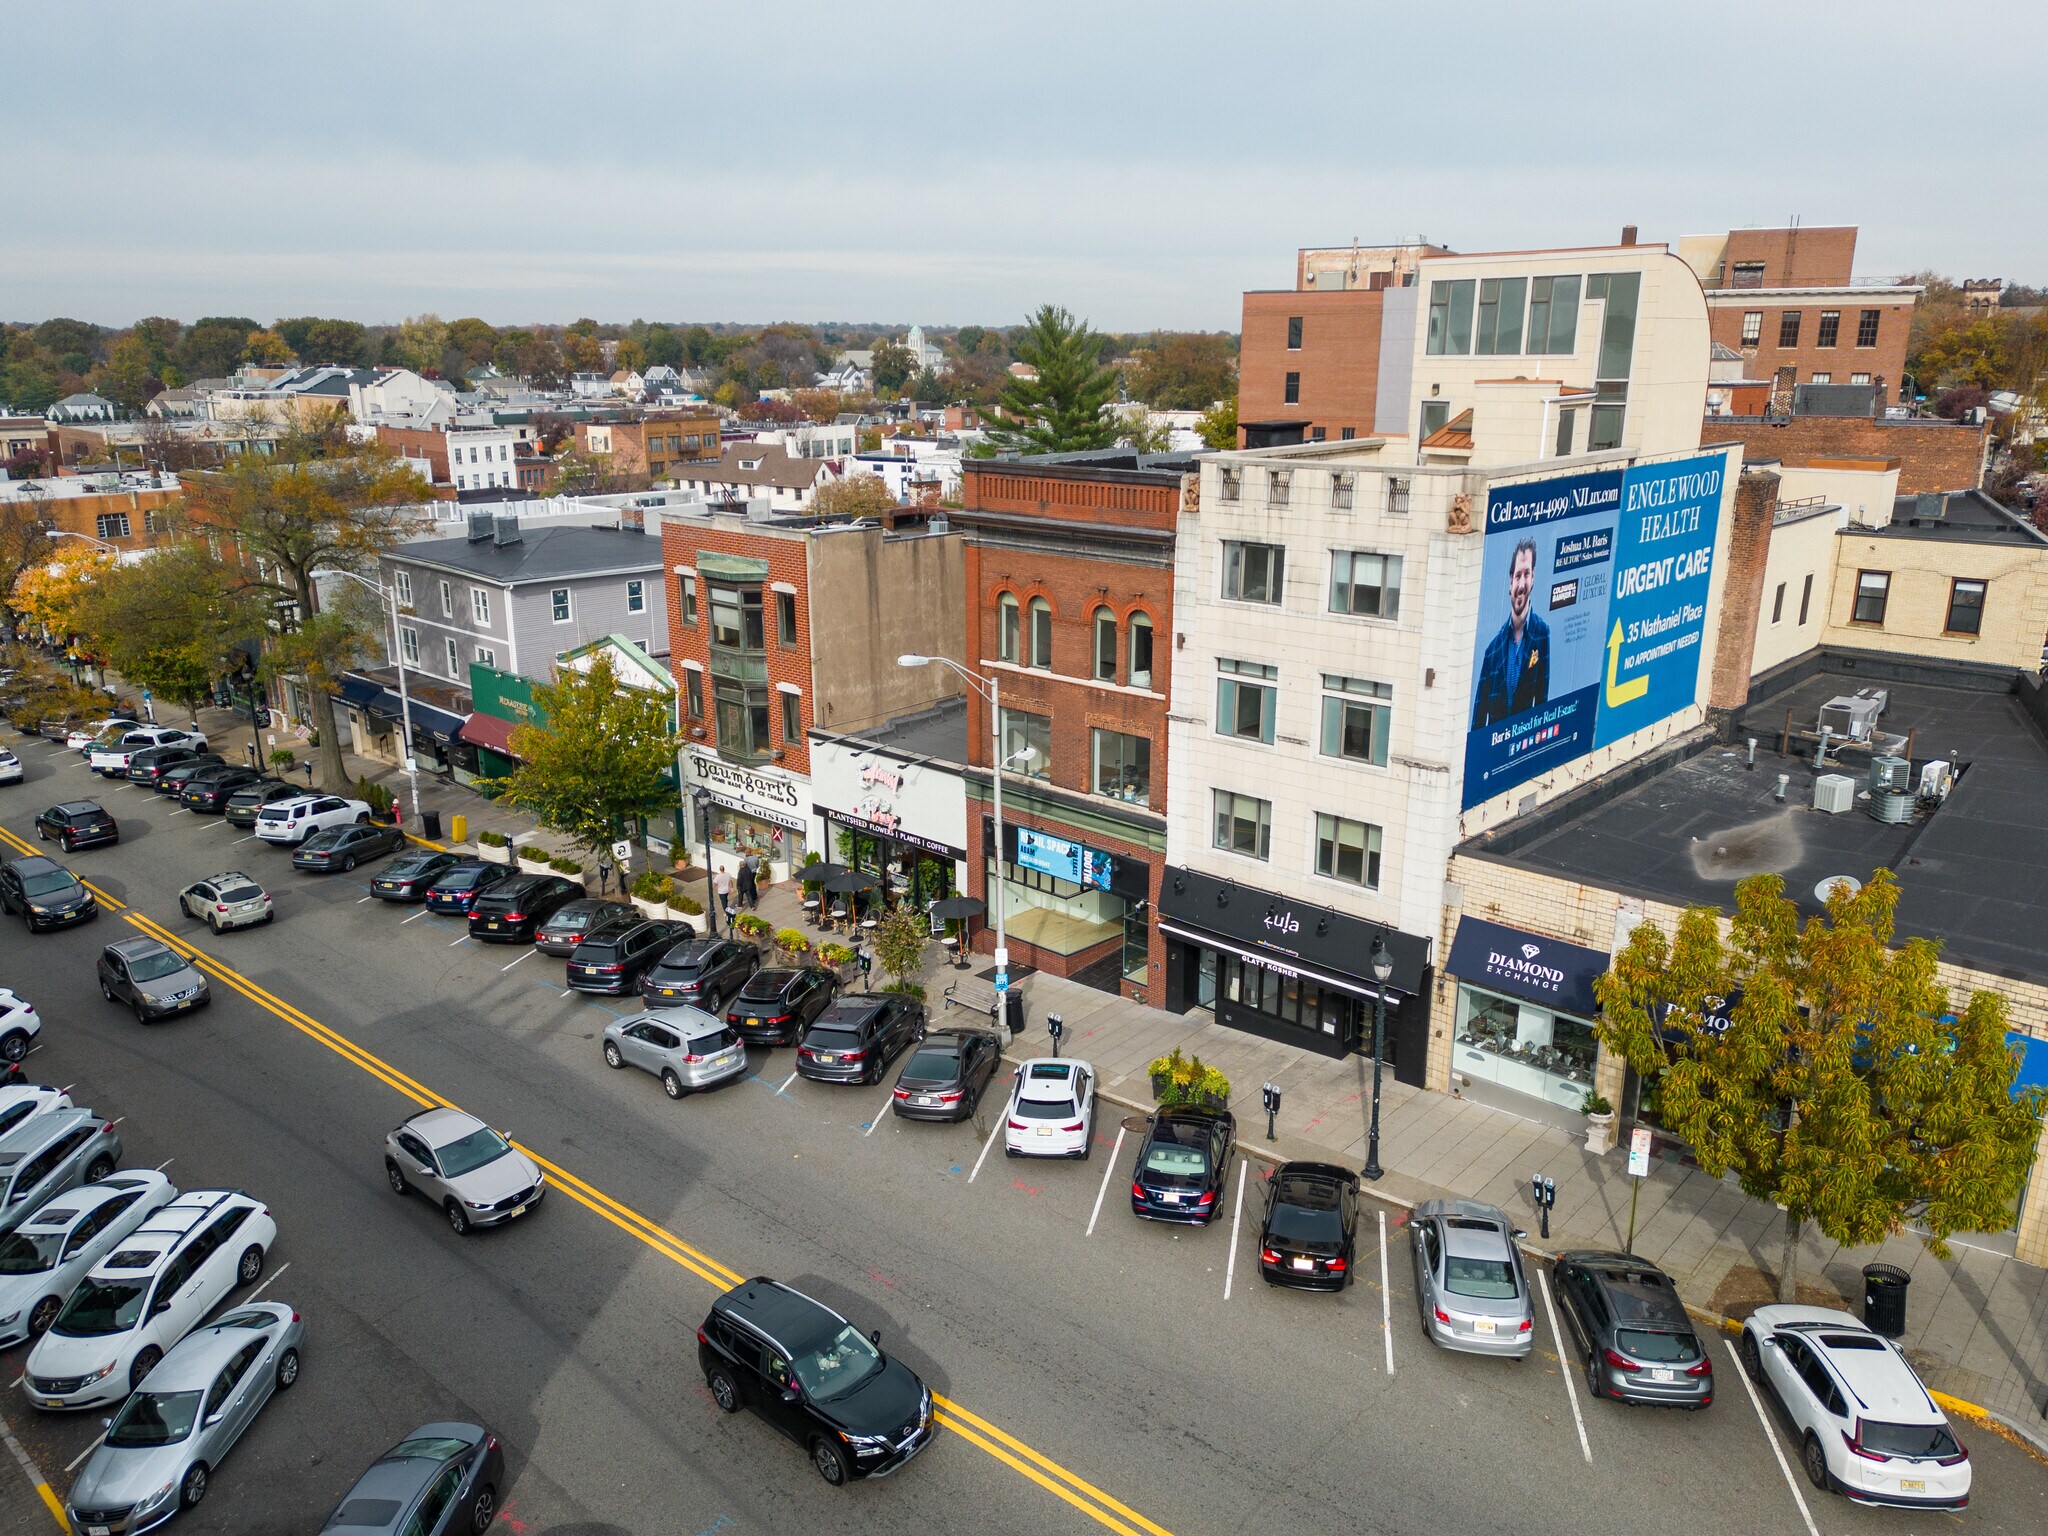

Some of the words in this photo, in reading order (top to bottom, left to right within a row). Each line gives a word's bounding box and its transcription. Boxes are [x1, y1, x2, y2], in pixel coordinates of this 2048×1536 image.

[1491, 501, 1512, 524] Cell
[1512, 496, 1569, 523] 201.741.4999
[1571, 486, 1619, 509] NJLux.com
[1626, 470, 1720, 512] ENGLEWOOD
[1639, 505, 1701, 544] HEALTH
[1560, 541, 1582, 555] Joshua
[1582, 538, 1591, 549] M.
[1592, 533, 1608, 547] Baris
[1584, 572, 1607, 588] GLOBAL
[1616, 556, 1674, 600] URGENT
[1675, 547, 1711, 582] CARE
[1583, 584, 1607, 601] LUXURY
[1627, 620, 1639, 644] 35
[1640, 607, 1682, 639] Nathaniel
[1681, 603, 1703, 621] Place
[1624, 655, 1634, 670] NO
[1634, 639, 1677, 669] APPOINTMENT
[1676, 630, 1700, 650] NEEDED
[1511, 717, 1533, 738] Raised
[1533, 715, 1543, 729] for
[1543, 707, 1557, 725] Real
[711, 775, 726, 785] HOME
[727, 780, 742, 790] MADE
[757, 790, 766, 798] ICE
[767, 792, 785, 803] CREAM
[741, 803, 799, 828] Cuisine
[828, 810, 868, 829] PLANTSHED
[869, 823, 895, 837] FLOWERS
[899, 832, 921, 845] PLANTS
[926, 841, 949, 855] COFFEE
[1083, 850, 1093, 884] BOOTH
[1241, 955, 1265, 968] GLATT
[1267, 963, 1298, 979] KOSHER
[1487, 965, 1560, 992] EXCHANGE
[1488, 952, 1564, 982] DIAMOND
